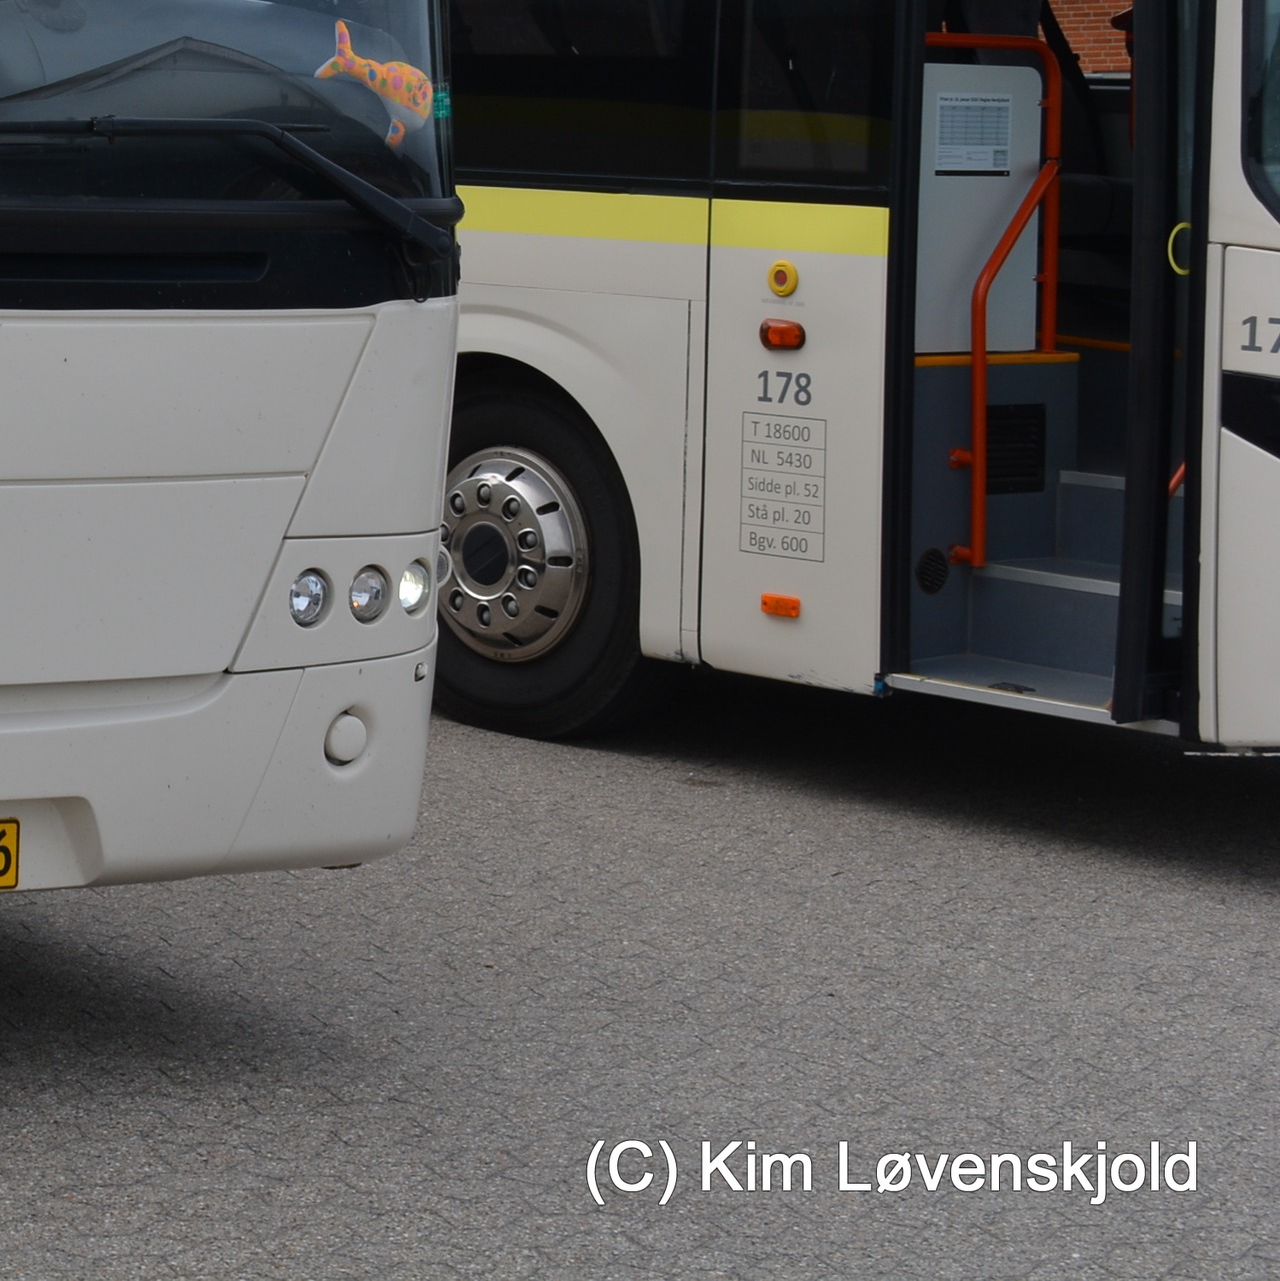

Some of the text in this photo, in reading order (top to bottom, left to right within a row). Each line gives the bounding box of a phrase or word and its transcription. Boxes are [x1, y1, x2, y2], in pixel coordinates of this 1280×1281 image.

[757, 370, 812, 406] 178
[751, 421, 811, 443] T 18600
[750, 449, 813, 470] NL 5430
[747, 476, 819, 499] Sidde pl. 52
[747, 503, 811, 525] Stå pl. 20
[749, 531, 809, 554] Bgv. 600
